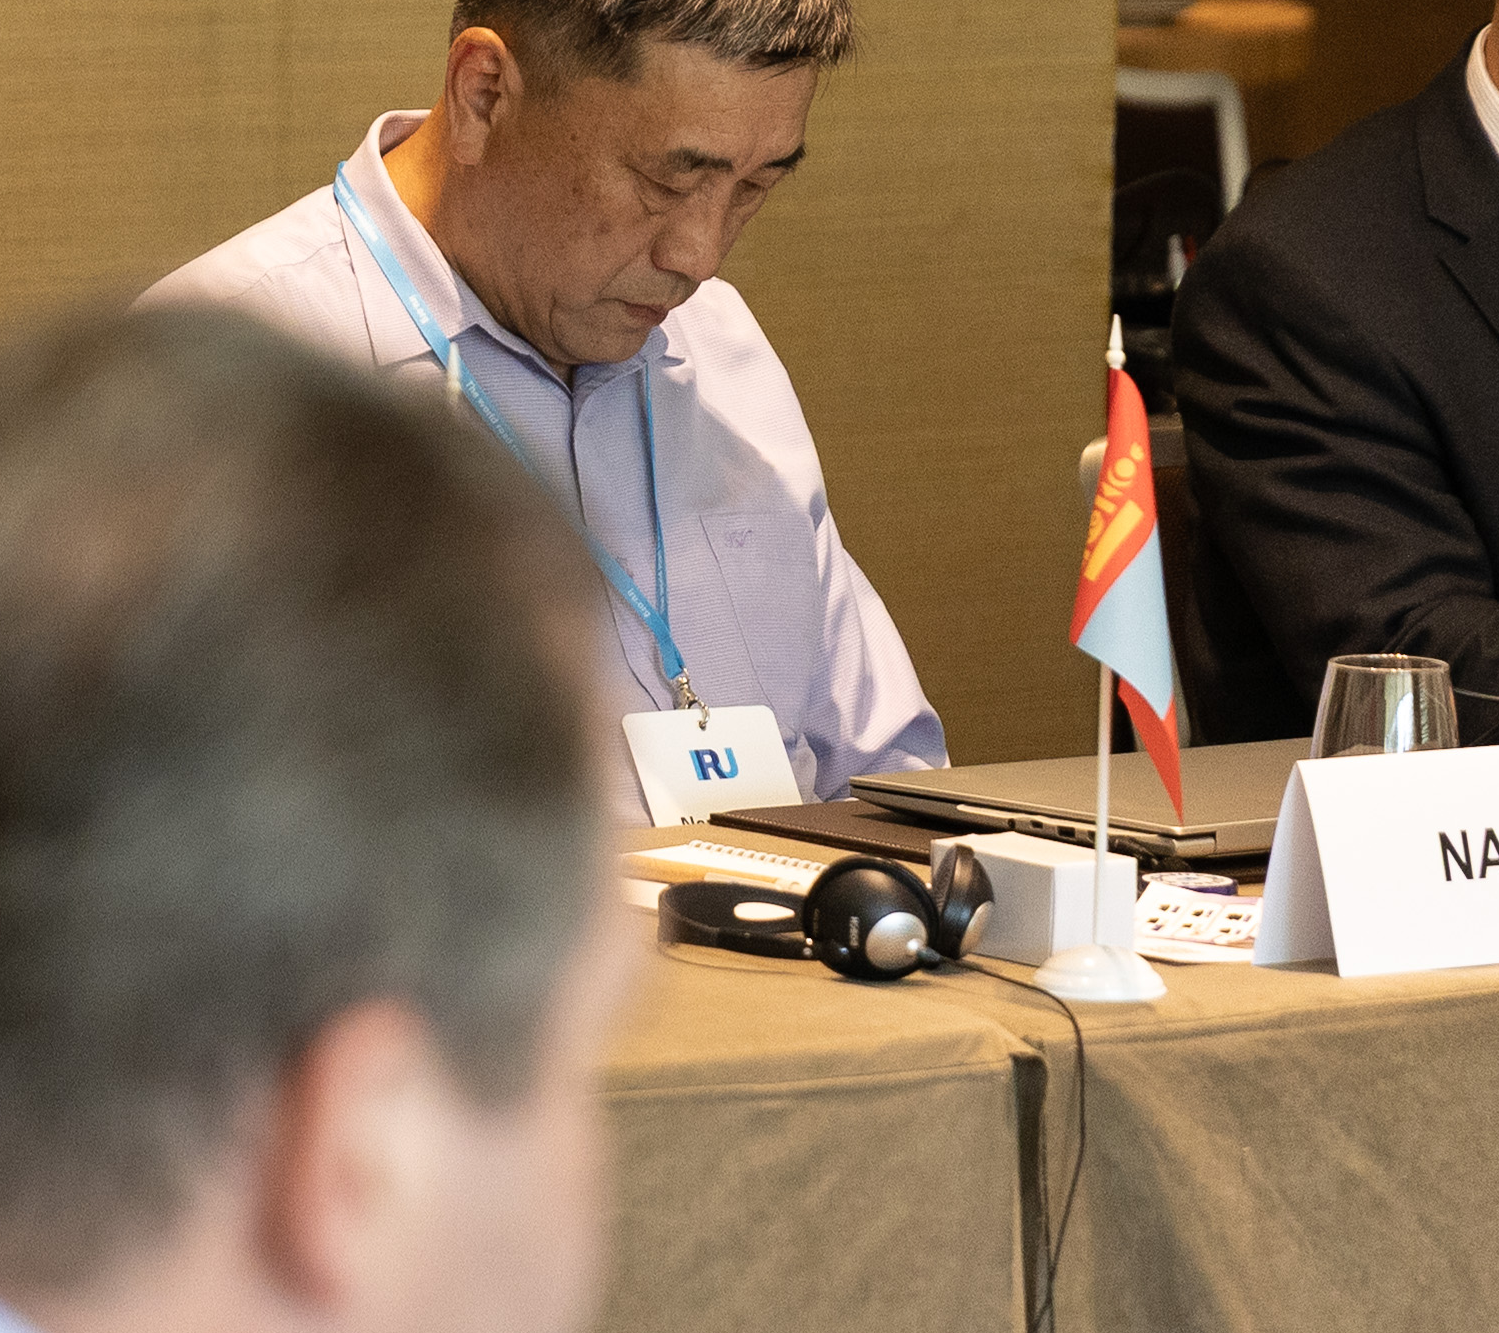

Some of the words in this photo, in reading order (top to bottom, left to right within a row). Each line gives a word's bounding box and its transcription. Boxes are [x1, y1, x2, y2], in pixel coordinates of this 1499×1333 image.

[463, 379, 482, 399] The
[475, 397, 499, 425] world
[626, 588, 652, 618] iru.org
[688, 747, 739, 781] IRU
